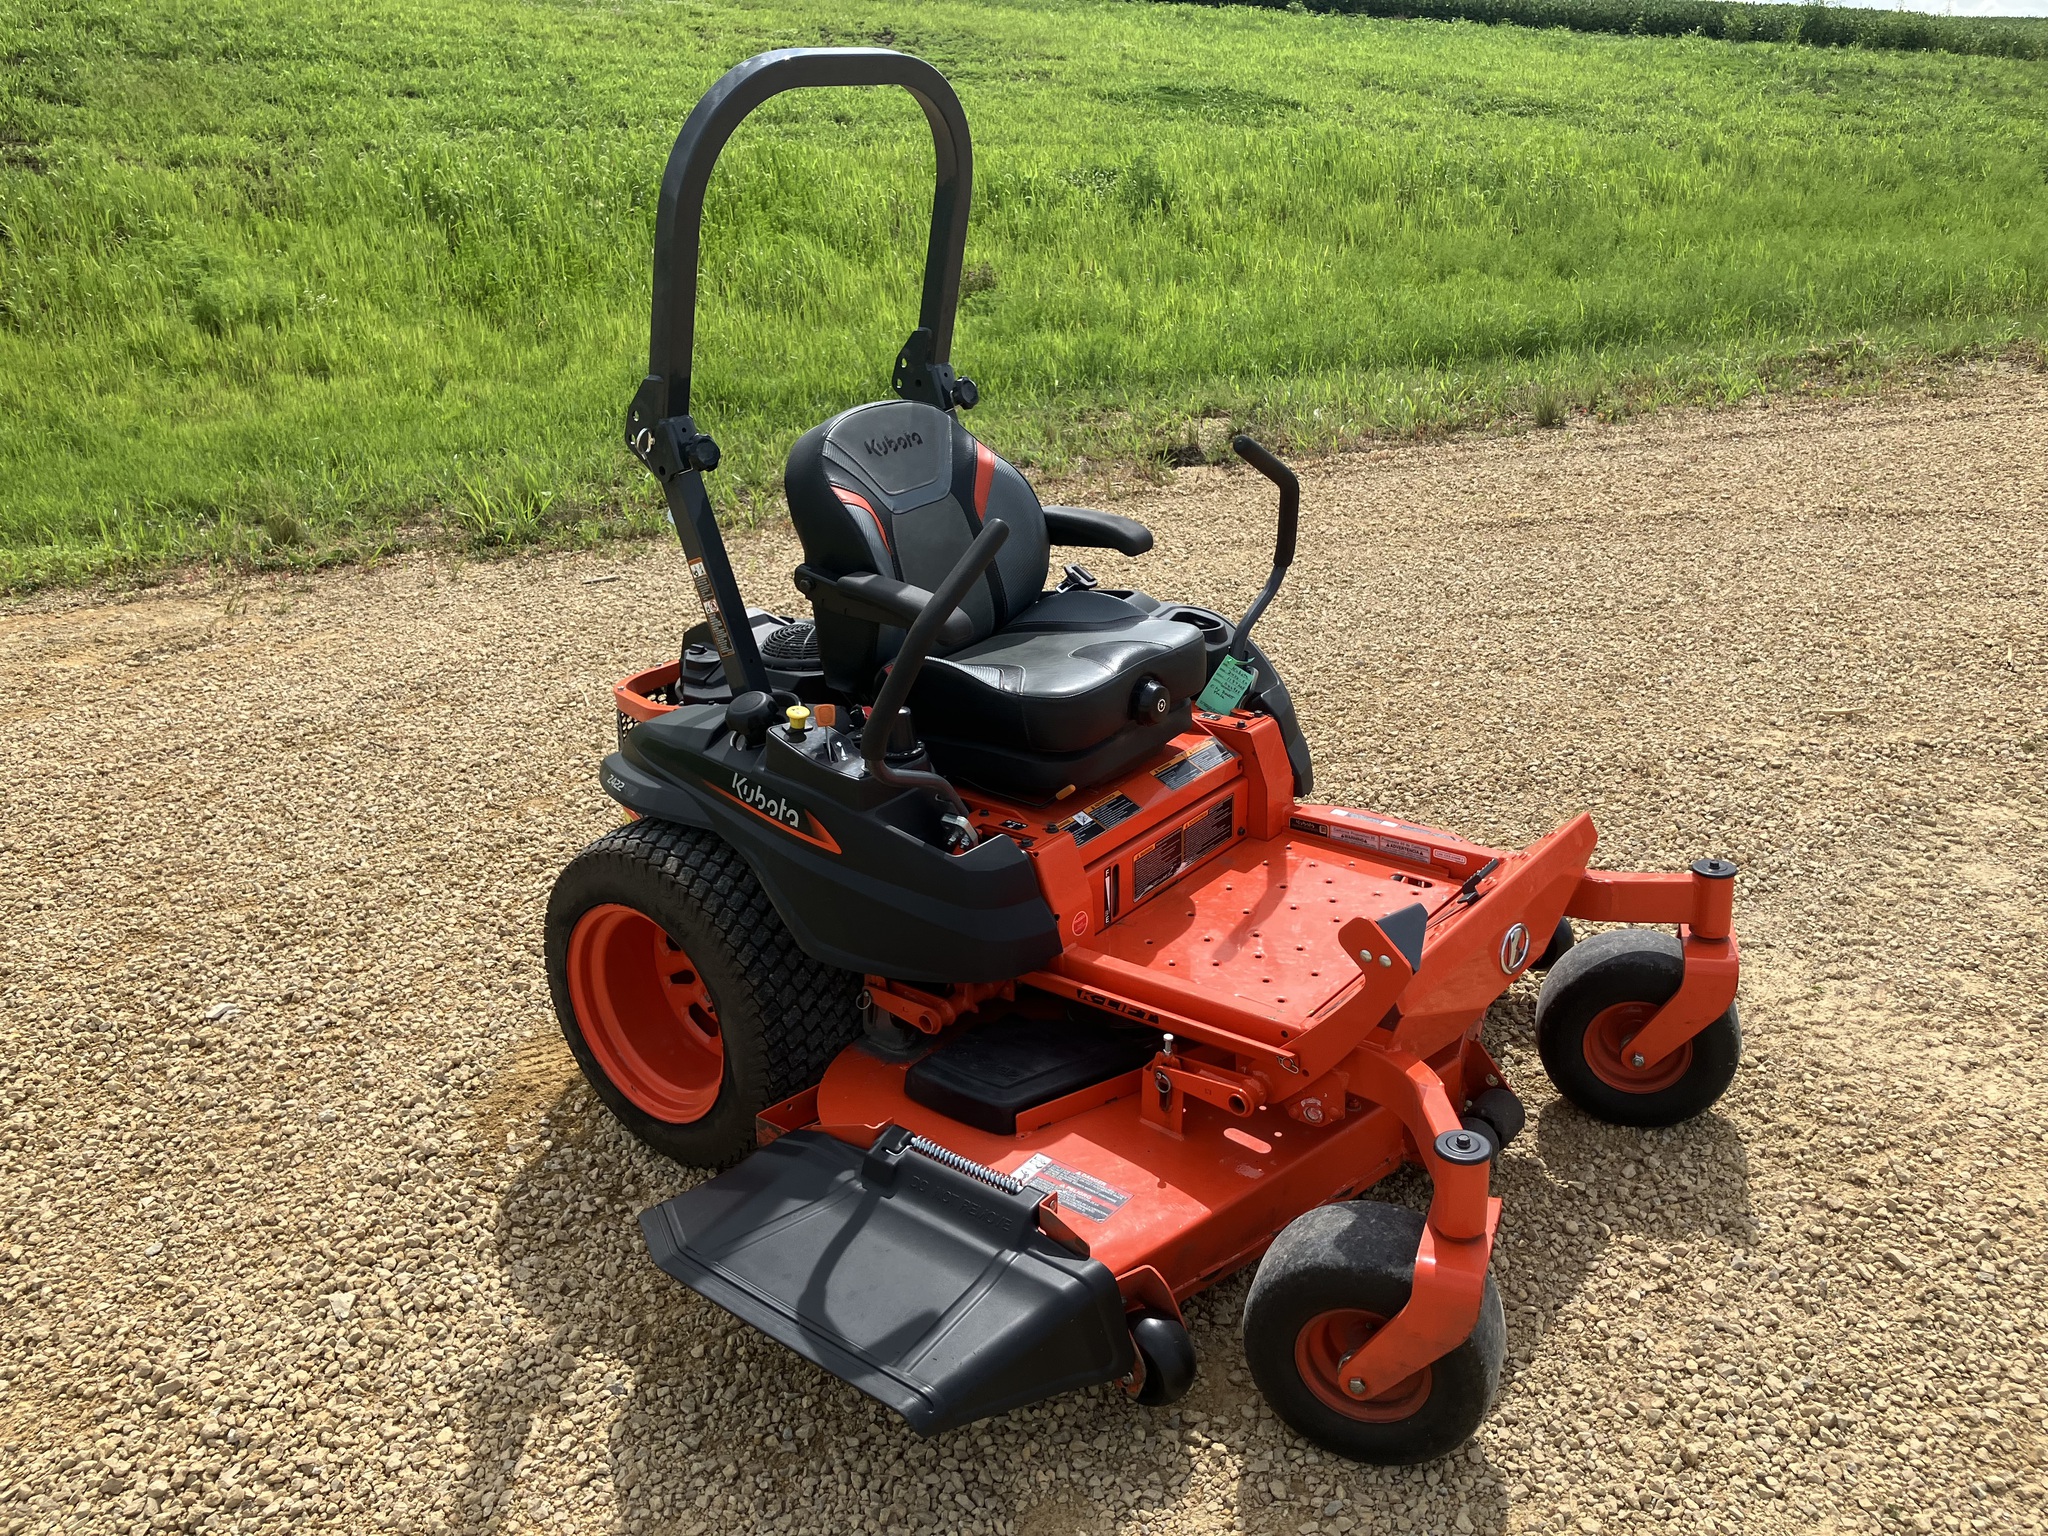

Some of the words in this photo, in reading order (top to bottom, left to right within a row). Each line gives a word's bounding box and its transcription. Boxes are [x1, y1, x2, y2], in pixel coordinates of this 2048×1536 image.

[864, 431, 923, 457] Kubota
[607, 774, 625, 791] Z422
[732, 772, 800, 828] Kubota
[1390, 844, 1420, 855] ADVERTENCIA
[1079, 988, 1156, 1021] K-LIFT
[1081, 1173, 1107, 1187] DANGER
[1066, 1186, 1093, 1199] PELIGRO
